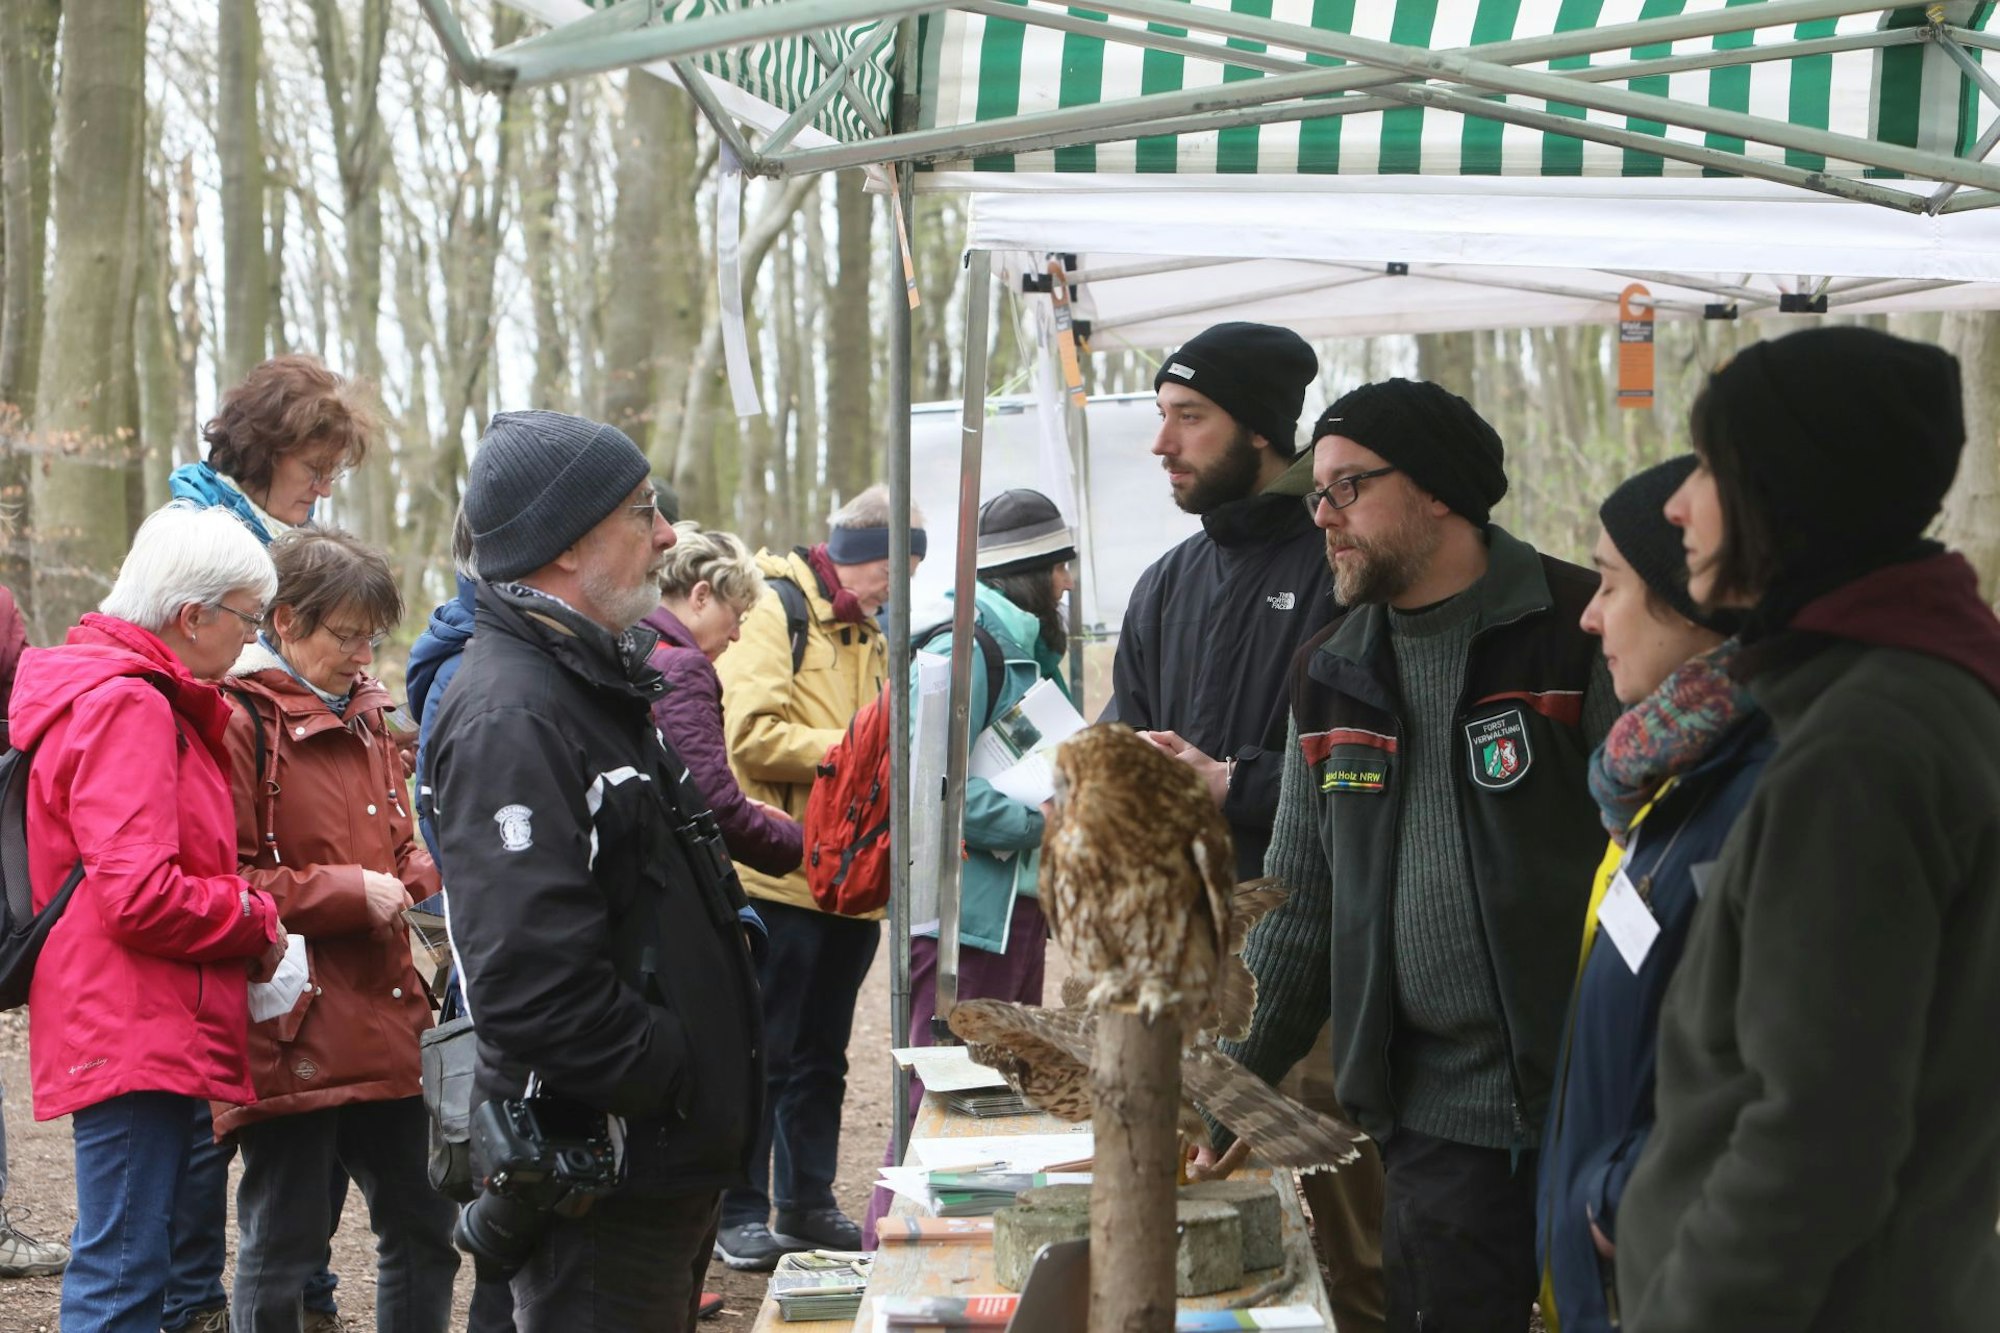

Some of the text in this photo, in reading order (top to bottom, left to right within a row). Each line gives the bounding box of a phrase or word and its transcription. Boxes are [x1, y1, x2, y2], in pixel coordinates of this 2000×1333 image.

[1482, 719, 1506, 733] FORST
[1472, 724, 1521, 746] VERWALTUNG
[1338, 770, 1358, 781] Holz
[1359, 771, 1381, 783] NRW
